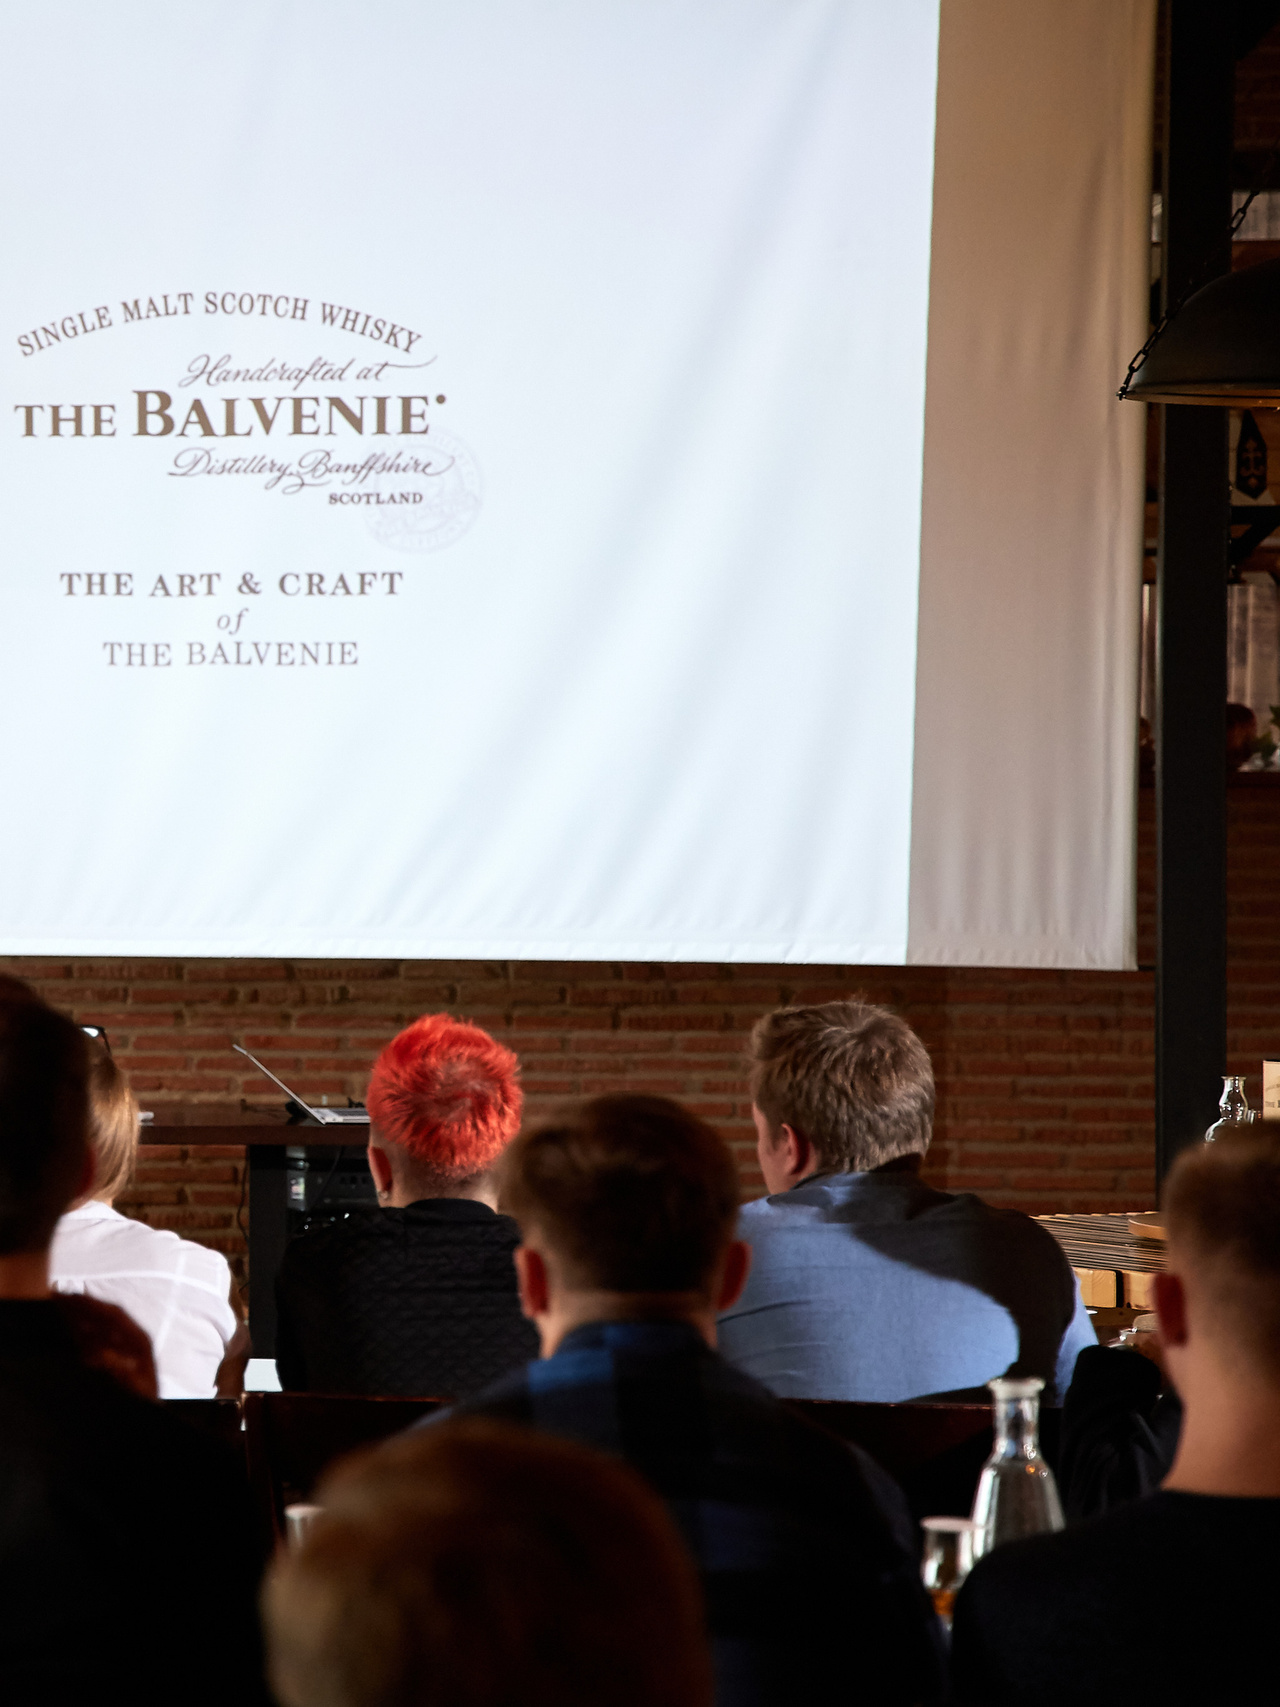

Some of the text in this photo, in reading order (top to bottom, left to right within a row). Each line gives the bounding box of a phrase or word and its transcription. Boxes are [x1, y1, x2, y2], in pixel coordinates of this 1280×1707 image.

[16, 292, 422, 358] SINGLE MALT SCOTCH WHISKY
[177, 354, 356, 392] Handcrafted
[14, 404, 117, 438] THE
[281, 449, 456, 495] Banffshire
[328, 491, 424, 506] SCOTLAND
[60, 571, 404, 598] THE ART & CRAFT
[216, 607, 250, 636] of
[102, 641, 359, 667] THE BALVENIE
